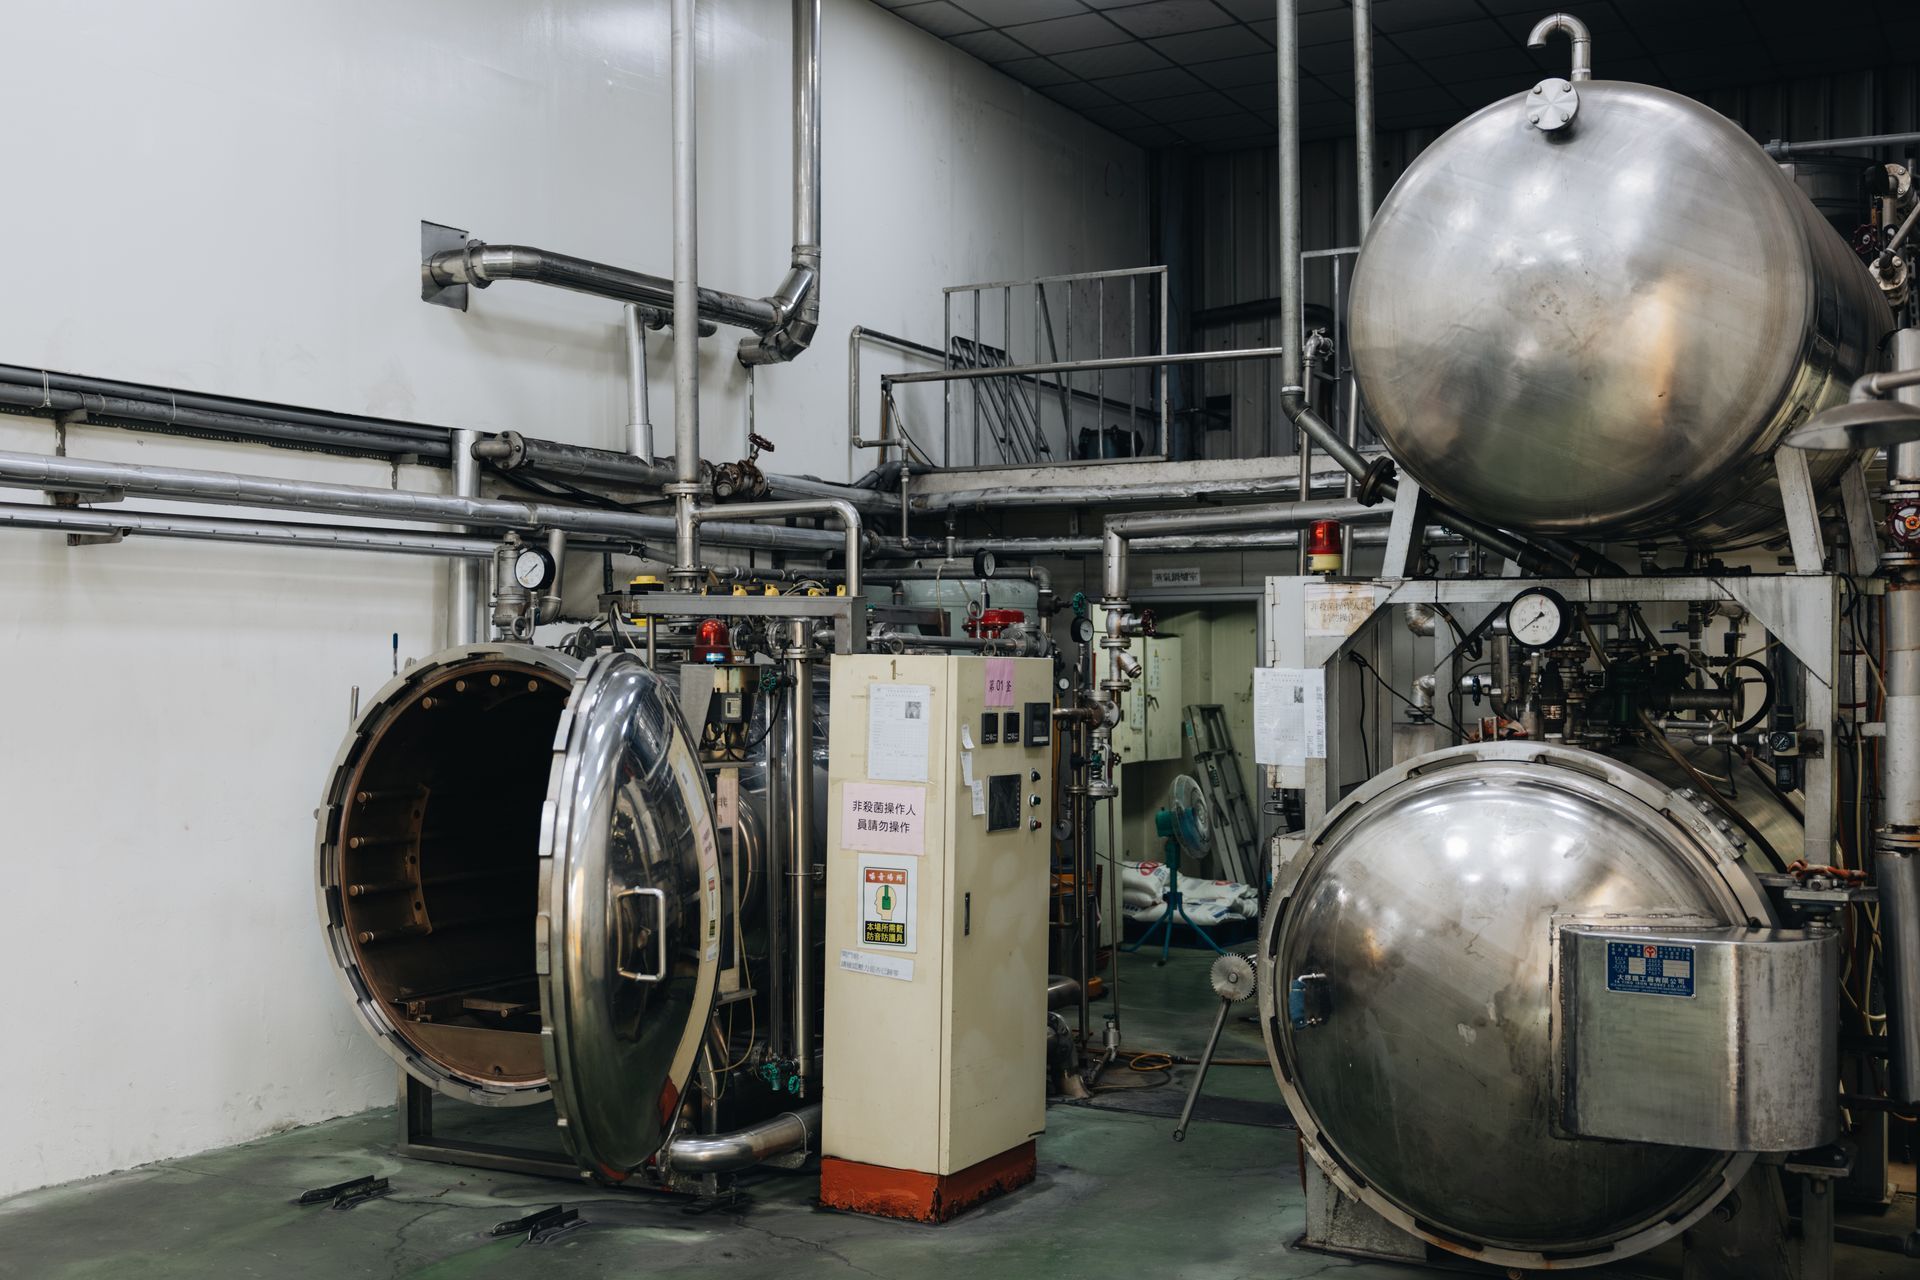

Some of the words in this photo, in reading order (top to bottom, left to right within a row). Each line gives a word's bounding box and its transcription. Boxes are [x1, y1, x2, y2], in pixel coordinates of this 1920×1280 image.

[889, 658, 898, 681] 1
[852, 799, 917, 817] 非殺菌操作人
[857, 818, 911, 834] 員請勿操作
[866, 931, 904, 944] 防音防護具
